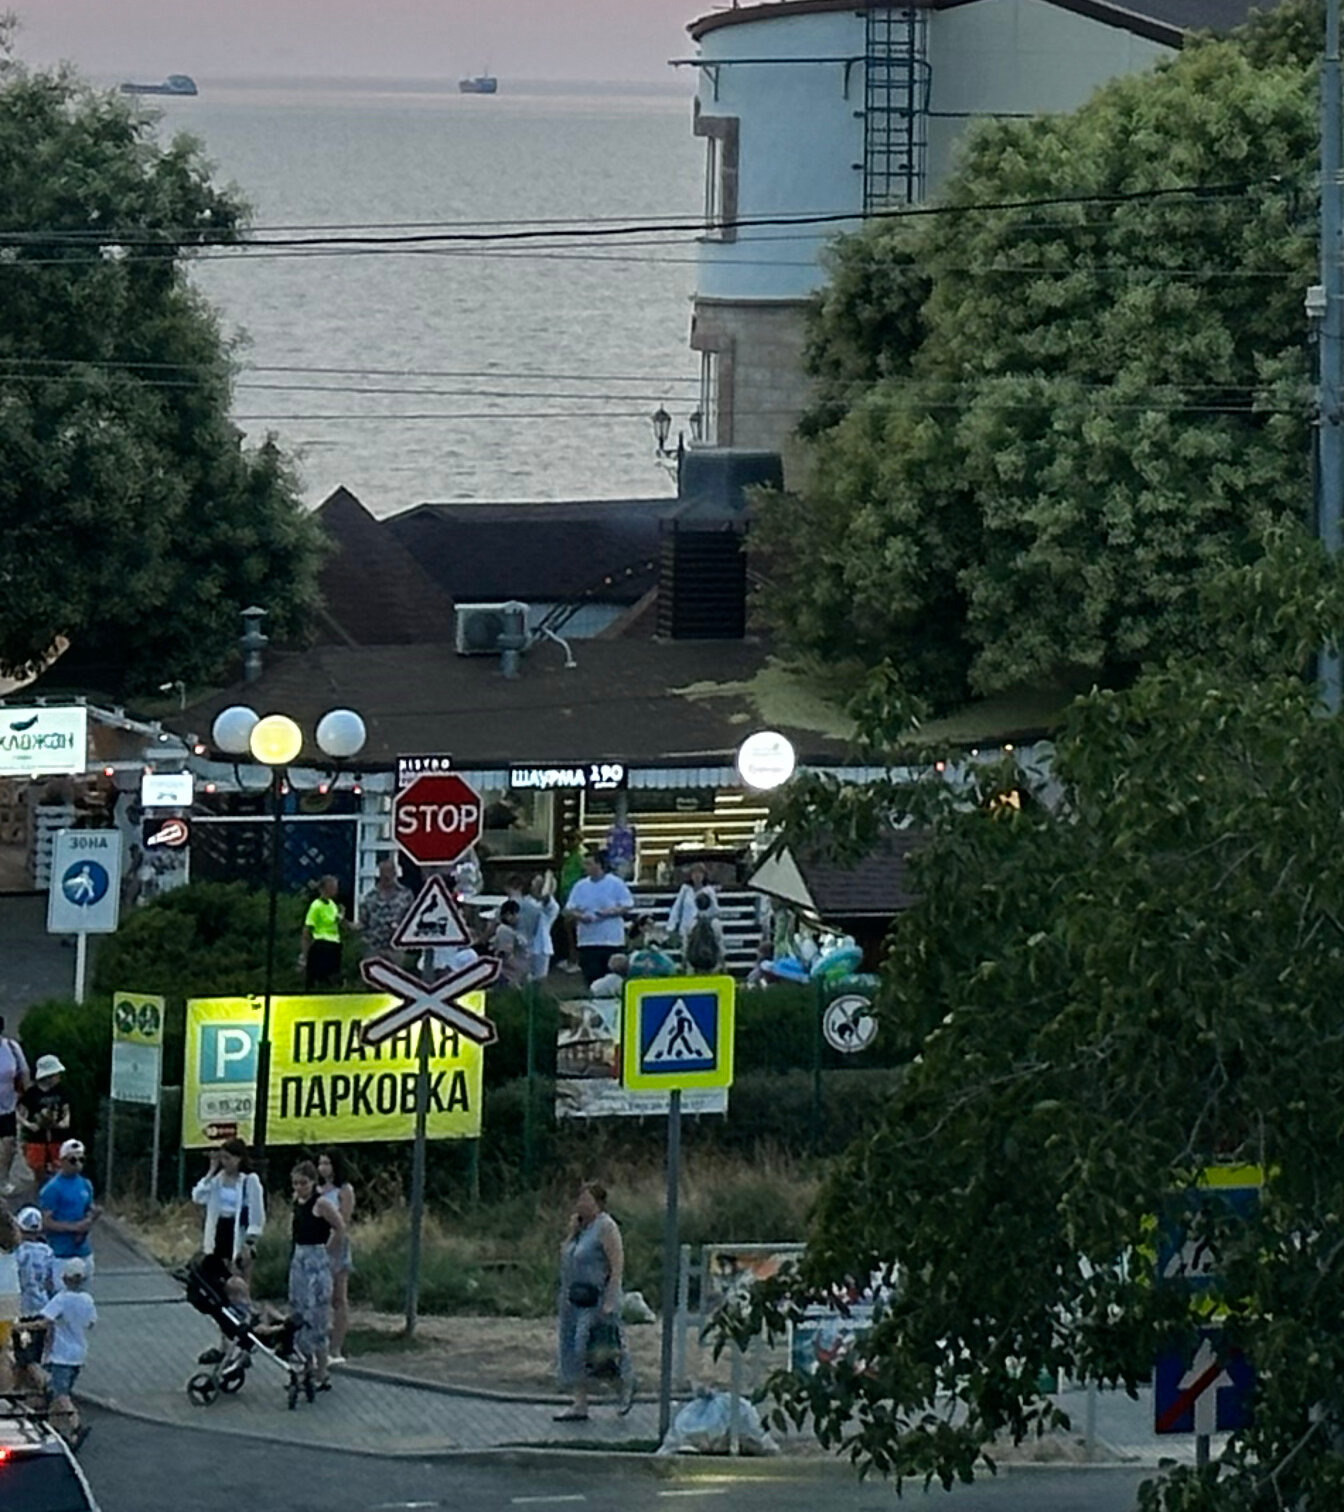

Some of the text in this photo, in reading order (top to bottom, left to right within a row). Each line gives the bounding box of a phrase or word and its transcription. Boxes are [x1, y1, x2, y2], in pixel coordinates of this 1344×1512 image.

[511, 769, 586, 789] ШАУРМА
[398, 804, 478, 835] STOP
[70, 836, 108, 849] ЗОНА
[280, 1070, 470, 1118] ПАРКОВКА
